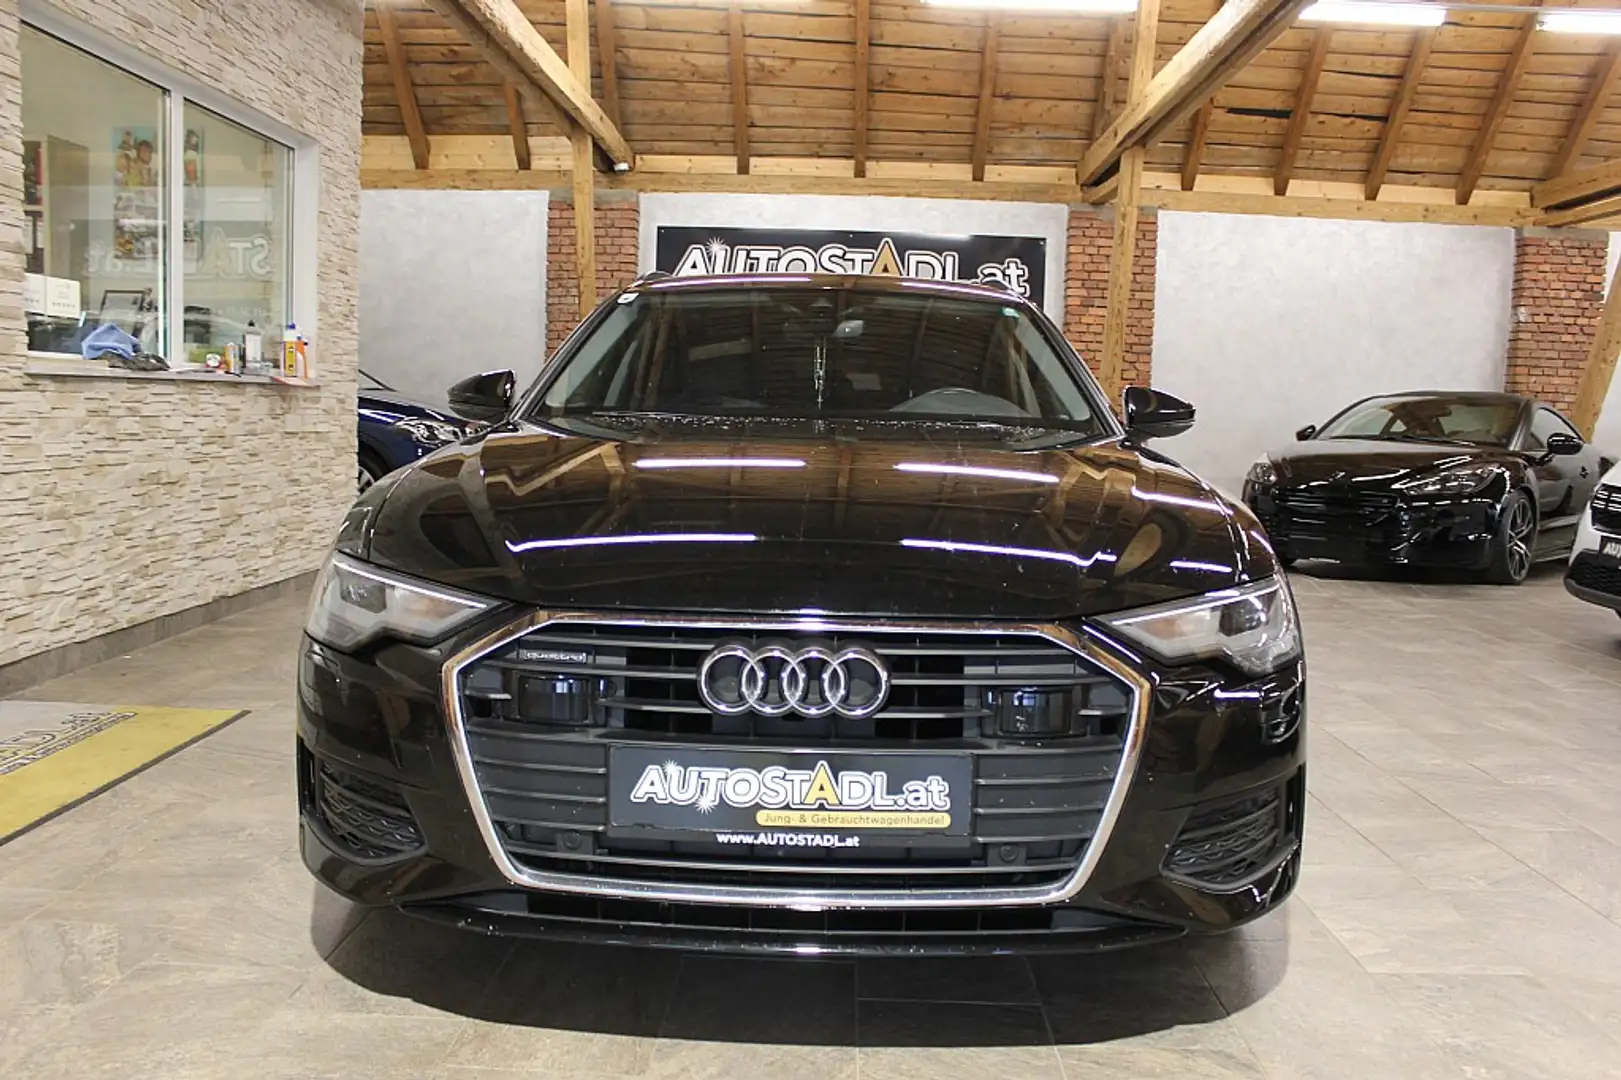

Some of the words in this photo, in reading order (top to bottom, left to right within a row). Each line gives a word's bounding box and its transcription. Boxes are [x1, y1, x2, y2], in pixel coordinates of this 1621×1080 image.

[630, 760, 951, 810] AUTOSTADL.at
[763, 813, 797, 825] Jung-
[799, 814, 807, 823] &
[811, 813, 946, 827] Gebrauchtwagenhandel
[716, 832, 860, 848] www.AUTOSTADL.at
